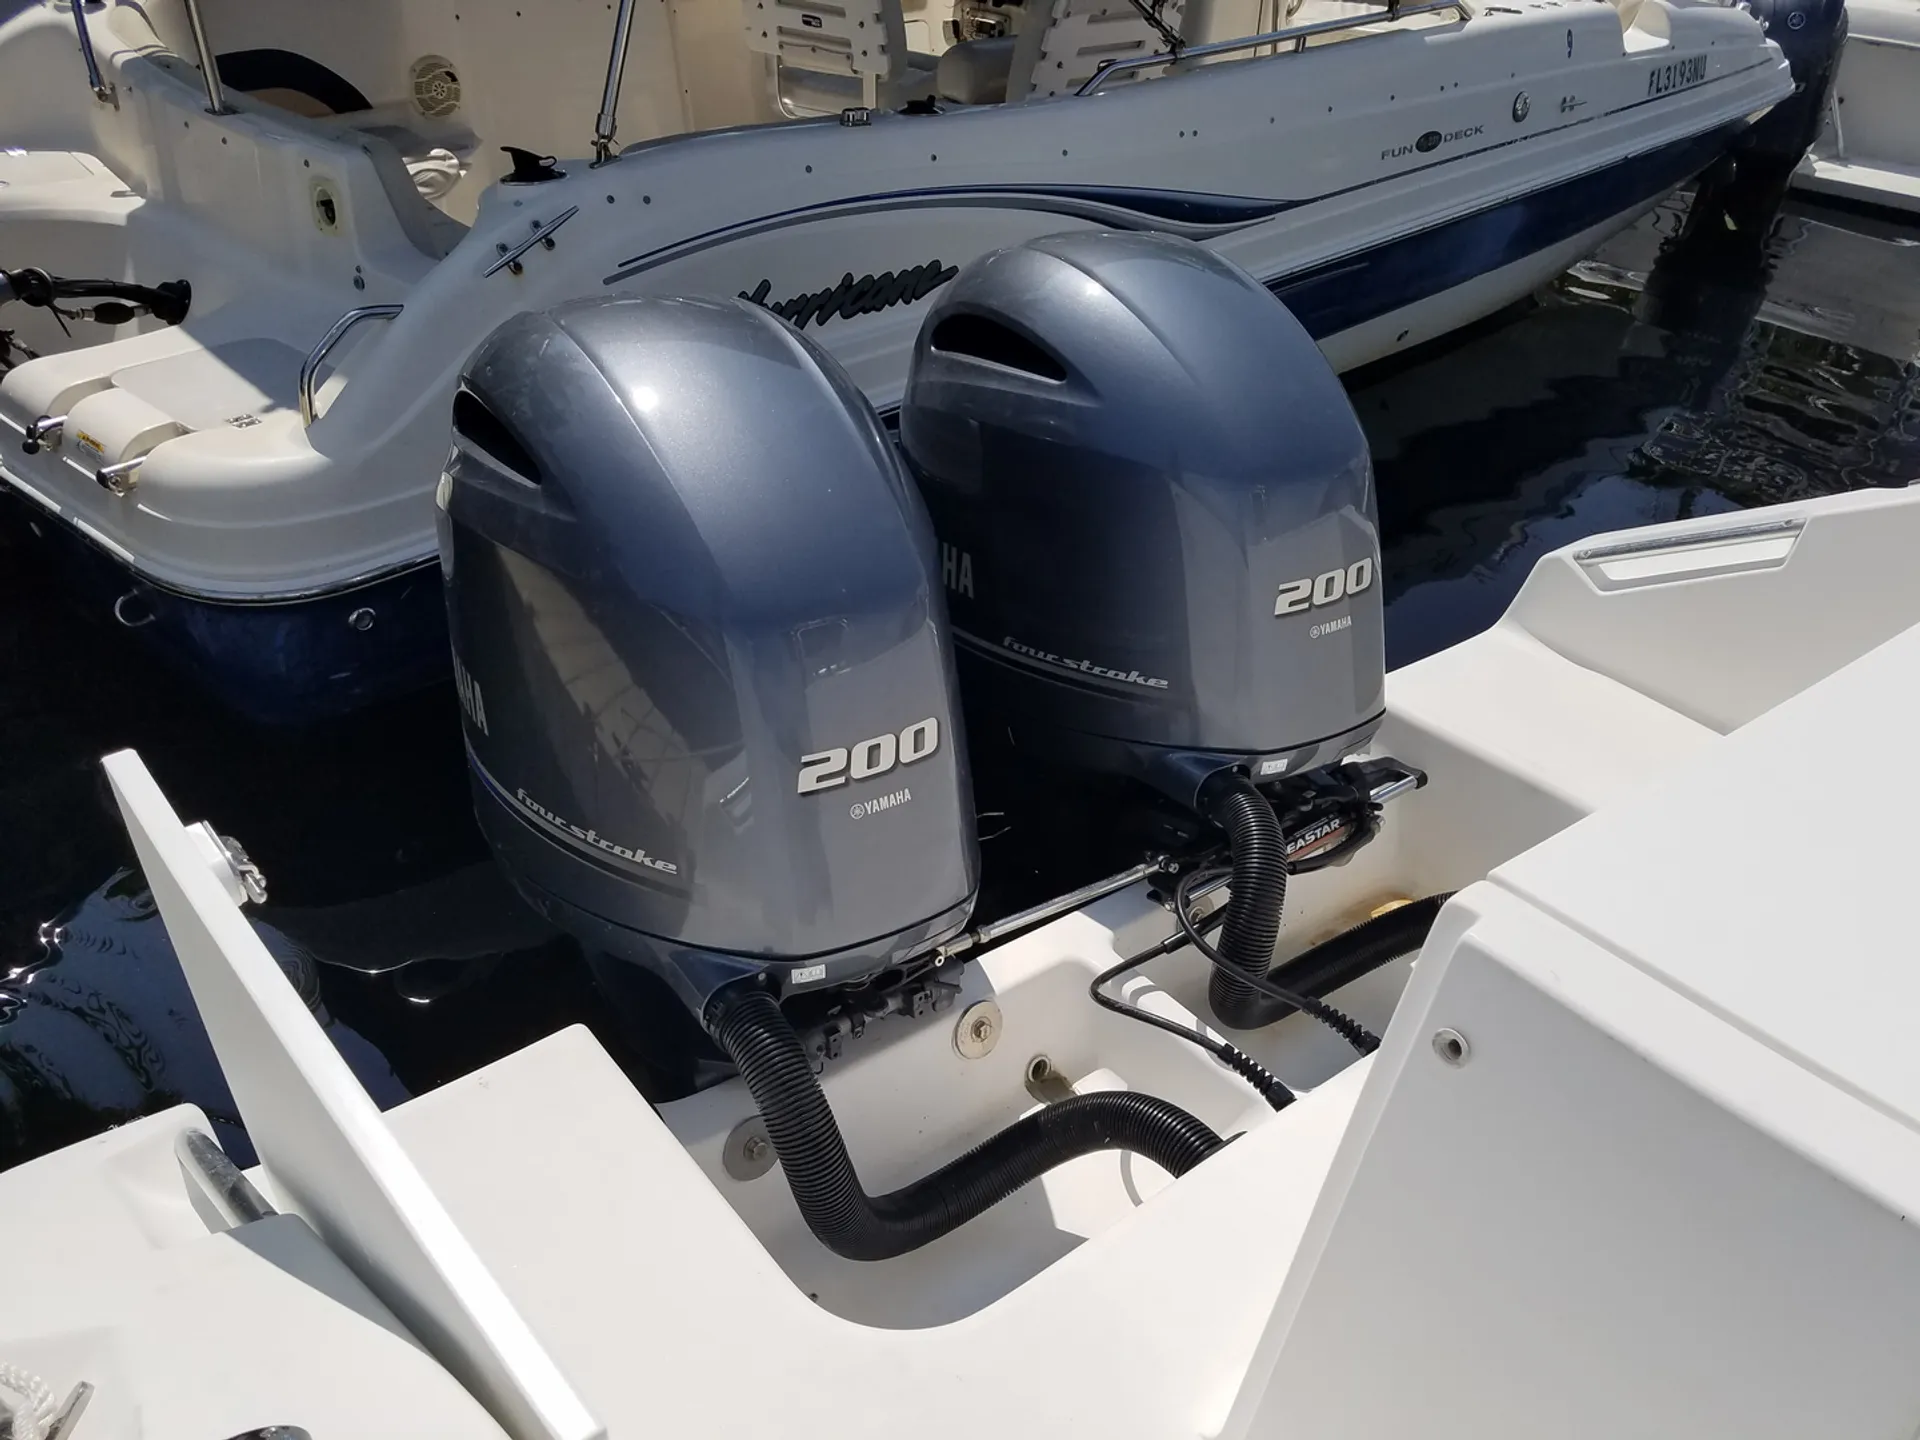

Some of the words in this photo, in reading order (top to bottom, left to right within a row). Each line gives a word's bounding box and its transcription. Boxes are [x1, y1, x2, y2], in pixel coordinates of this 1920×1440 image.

[1566, 28, 1574, 59] 9
[1381, 144, 1414, 160] FUN
[1443, 124, 1484, 143] DECK
[1274, 557, 1373, 616] 200
[1320, 615, 1352, 635] YAMAHA
[797, 717, 939, 794] 200
[864, 788, 912, 815] YAMAHA
[1286, 818, 1341, 855] EASTAR
